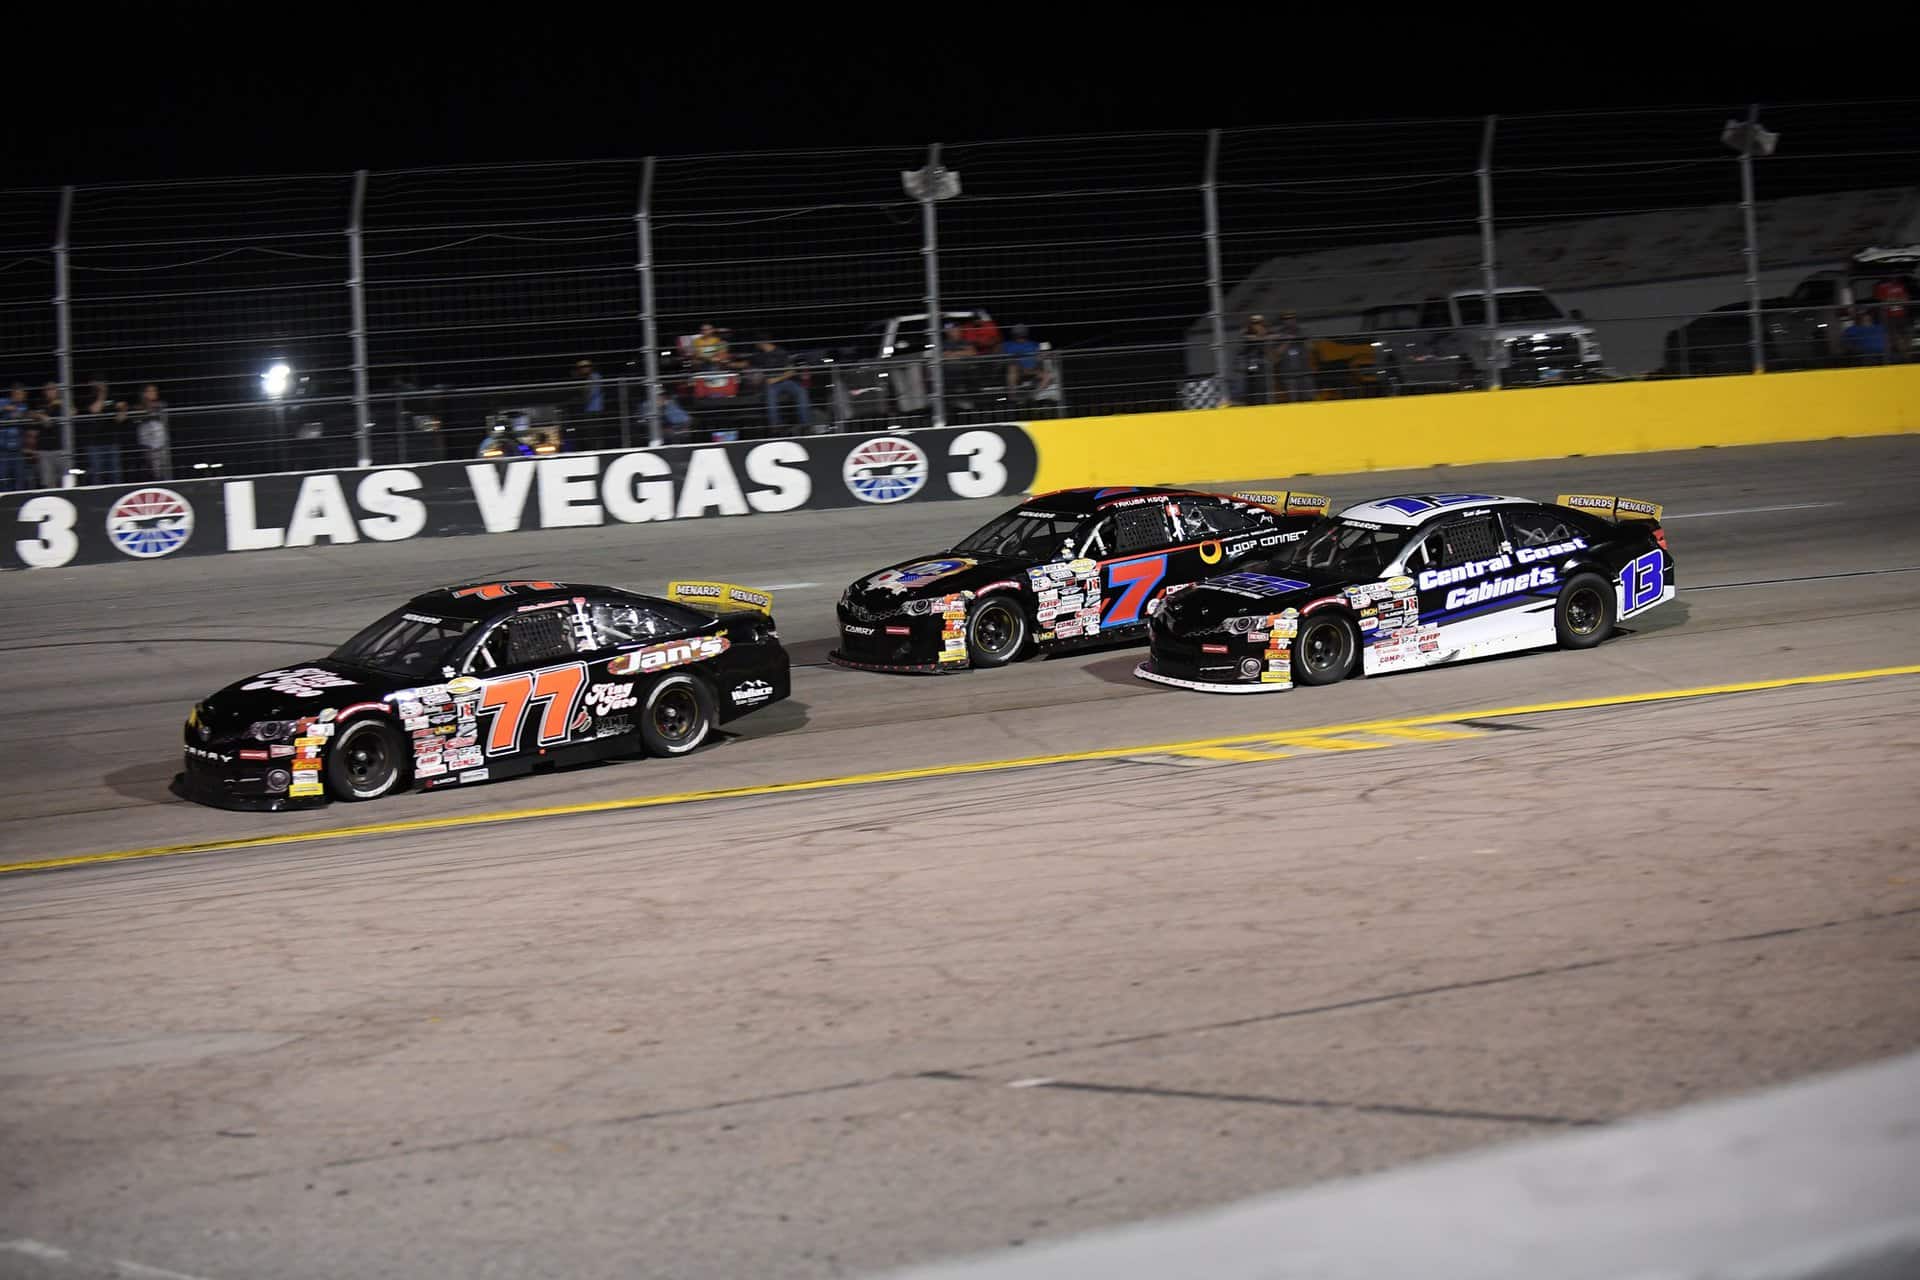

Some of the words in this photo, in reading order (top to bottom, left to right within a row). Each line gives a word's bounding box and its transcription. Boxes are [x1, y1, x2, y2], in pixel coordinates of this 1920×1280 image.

[947, 431, 1008, 498] 3
[224, 469, 428, 551] LAS
[466, 441, 811, 532] VEGAS
[1288, 496, 1327, 506] MENARDS
[1568, 497, 1613, 509] MENARDS
[1617, 501, 1657, 514] MENARDS
[15, 496, 79, 569] 3
[1225, 540, 1258, 555] LOOP
[1419, 554, 1512, 591] Central
[1516, 537, 1588, 563] Coast
[676, 585, 721, 597] MENARDS
[1101, 554, 1168, 628] 7
[1445, 566, 1556, 610] Cabinets
[1619, 549, 1665, 615] 13
[730, 589, 769, 607] MENARDS
[845, 624, 875, 636] CAMRY
[621, 637, 723, 674] Jan's
[585, 682, 634, 705] King
[596, 696, 638, 716] Taco
[478, 661, 589, 757] 77
